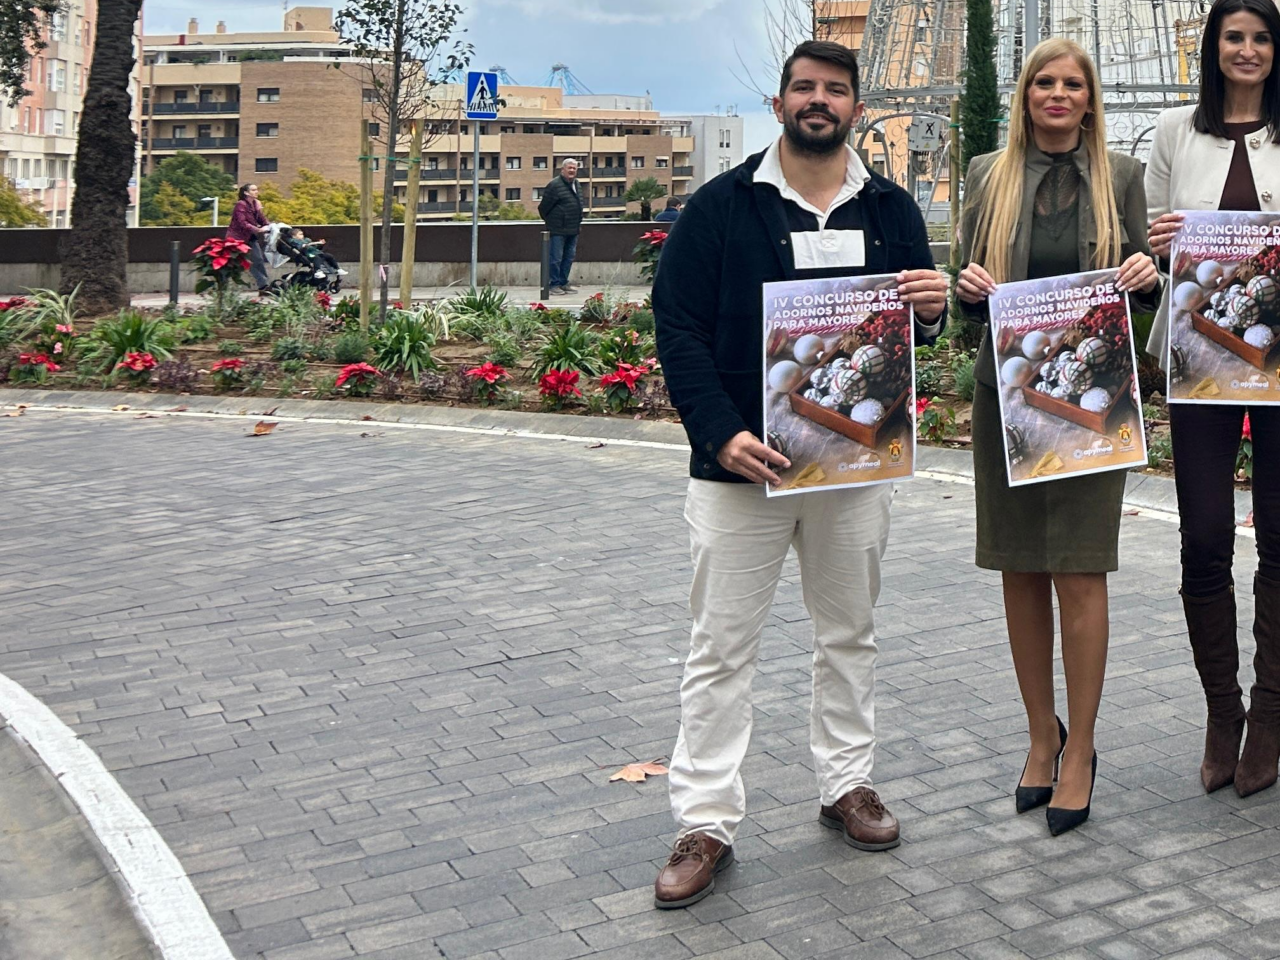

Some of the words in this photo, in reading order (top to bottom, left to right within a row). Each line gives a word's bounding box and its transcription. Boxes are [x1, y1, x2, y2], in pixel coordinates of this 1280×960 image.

[1197, 224, 1270, 236] CONCURSO
[1180, 235, 1231, 245] ADORNOS
[1180, 245, 1207, 254] PARA
[1210, 245, 1260, 255] MAYORES
[774, 297, 788, 308] IV
[793, 291, 875, 307] CONCURSO
[879, 289, 898, 300] DE
[999, 298, 1012, 309] IV
[1016, 286, 1093, 306] CONCURSO
[1095, 283, 1114, 295] DE
[774, 307, 833, 319] ADORNOS
[835, 301, 904, 314] NAVIDEÑOS
[1000, 304, 1054, 319] ADORNOS
[1057, 294, 1120, 310] NAVIDEÑOS
[774, 321, 806, 330] PARA
[809, 315, 865, 327] MAYORES
[1001, 318, 1031, 329] PARA
[1033, 310, 1085, 325] MAYORES
